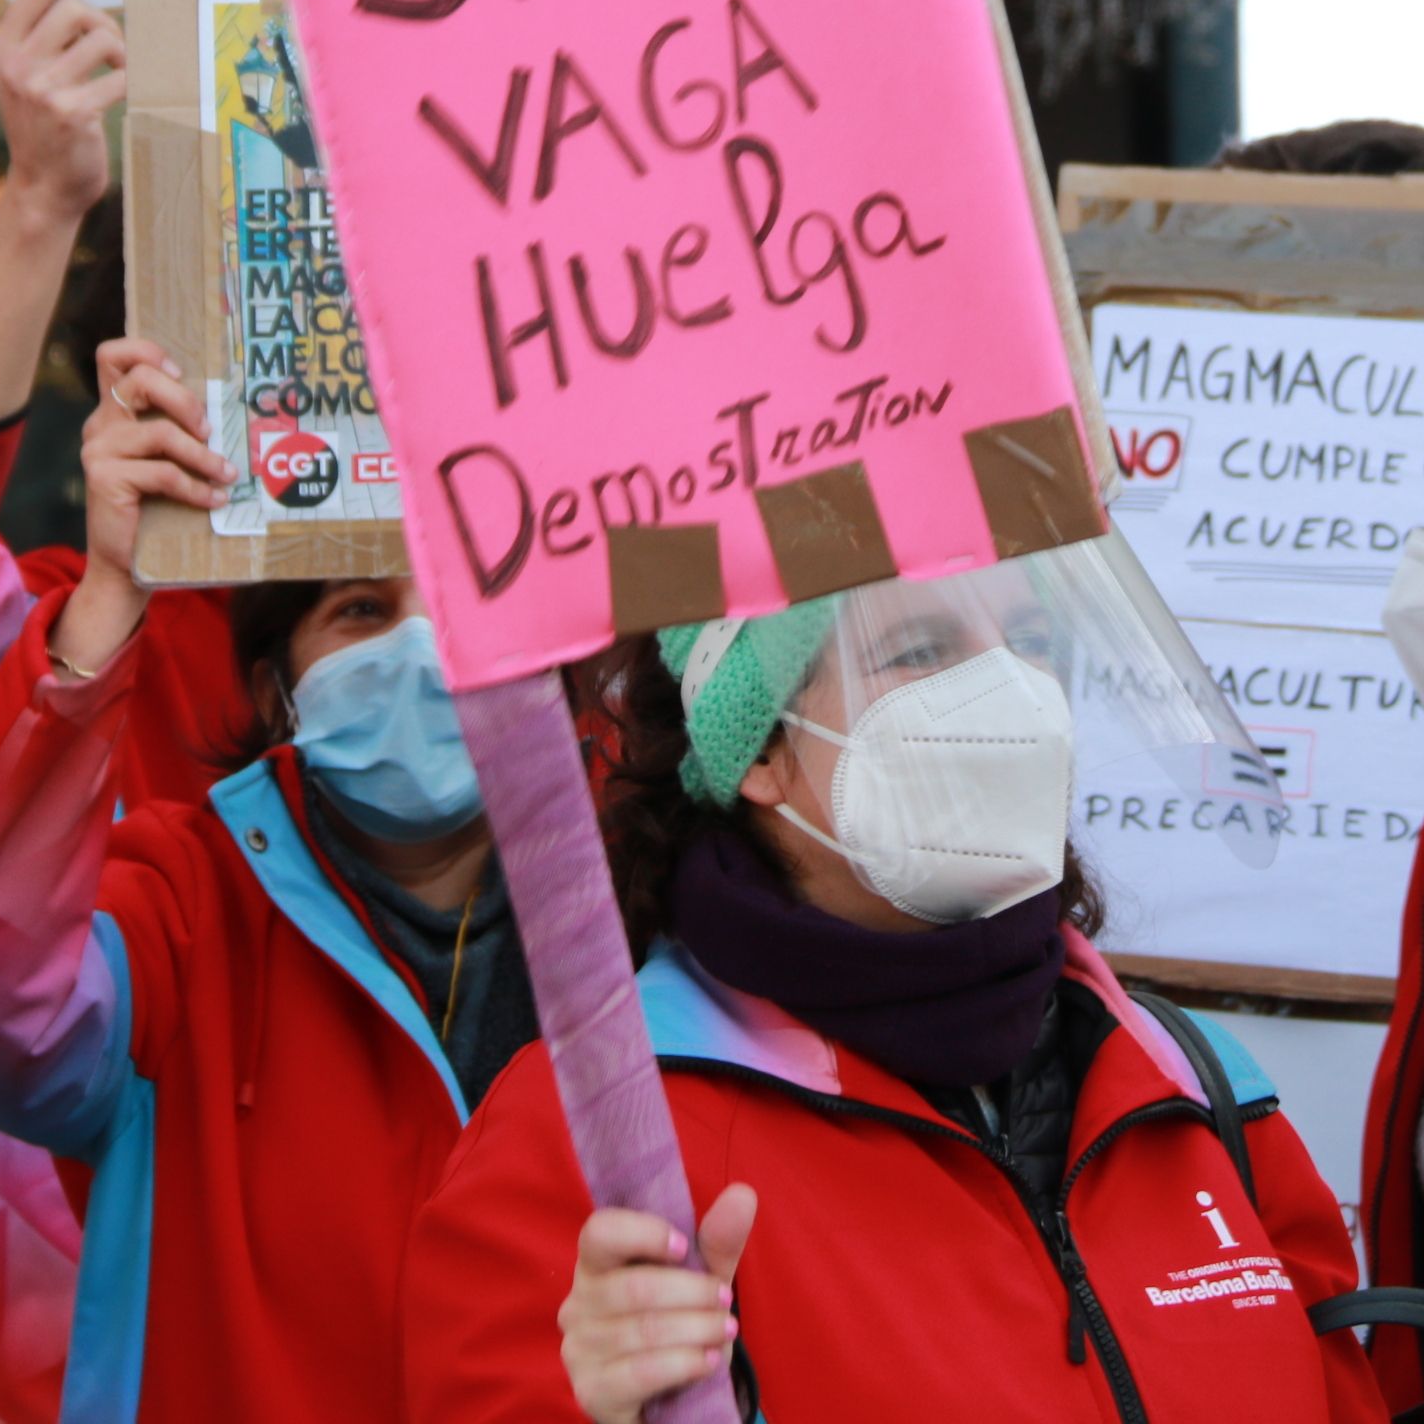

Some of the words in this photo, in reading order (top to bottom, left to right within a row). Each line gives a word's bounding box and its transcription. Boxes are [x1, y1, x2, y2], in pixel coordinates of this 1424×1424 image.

[249, 226, 341, 260] ERTE
[249, 303, 302, 337] LA
[247, 342, 307, 377] ME
[249, 381, 379, 418] COMO
[268, 452, 331, 479] CGT
[1219, 438, 1407, 484] CUMPLE
[299, 482, 328, 497] BBT
[1187, 1261, 1233, 1278] ORIGINAL
[1145, 1278, 1247, 1306] Barcelona
